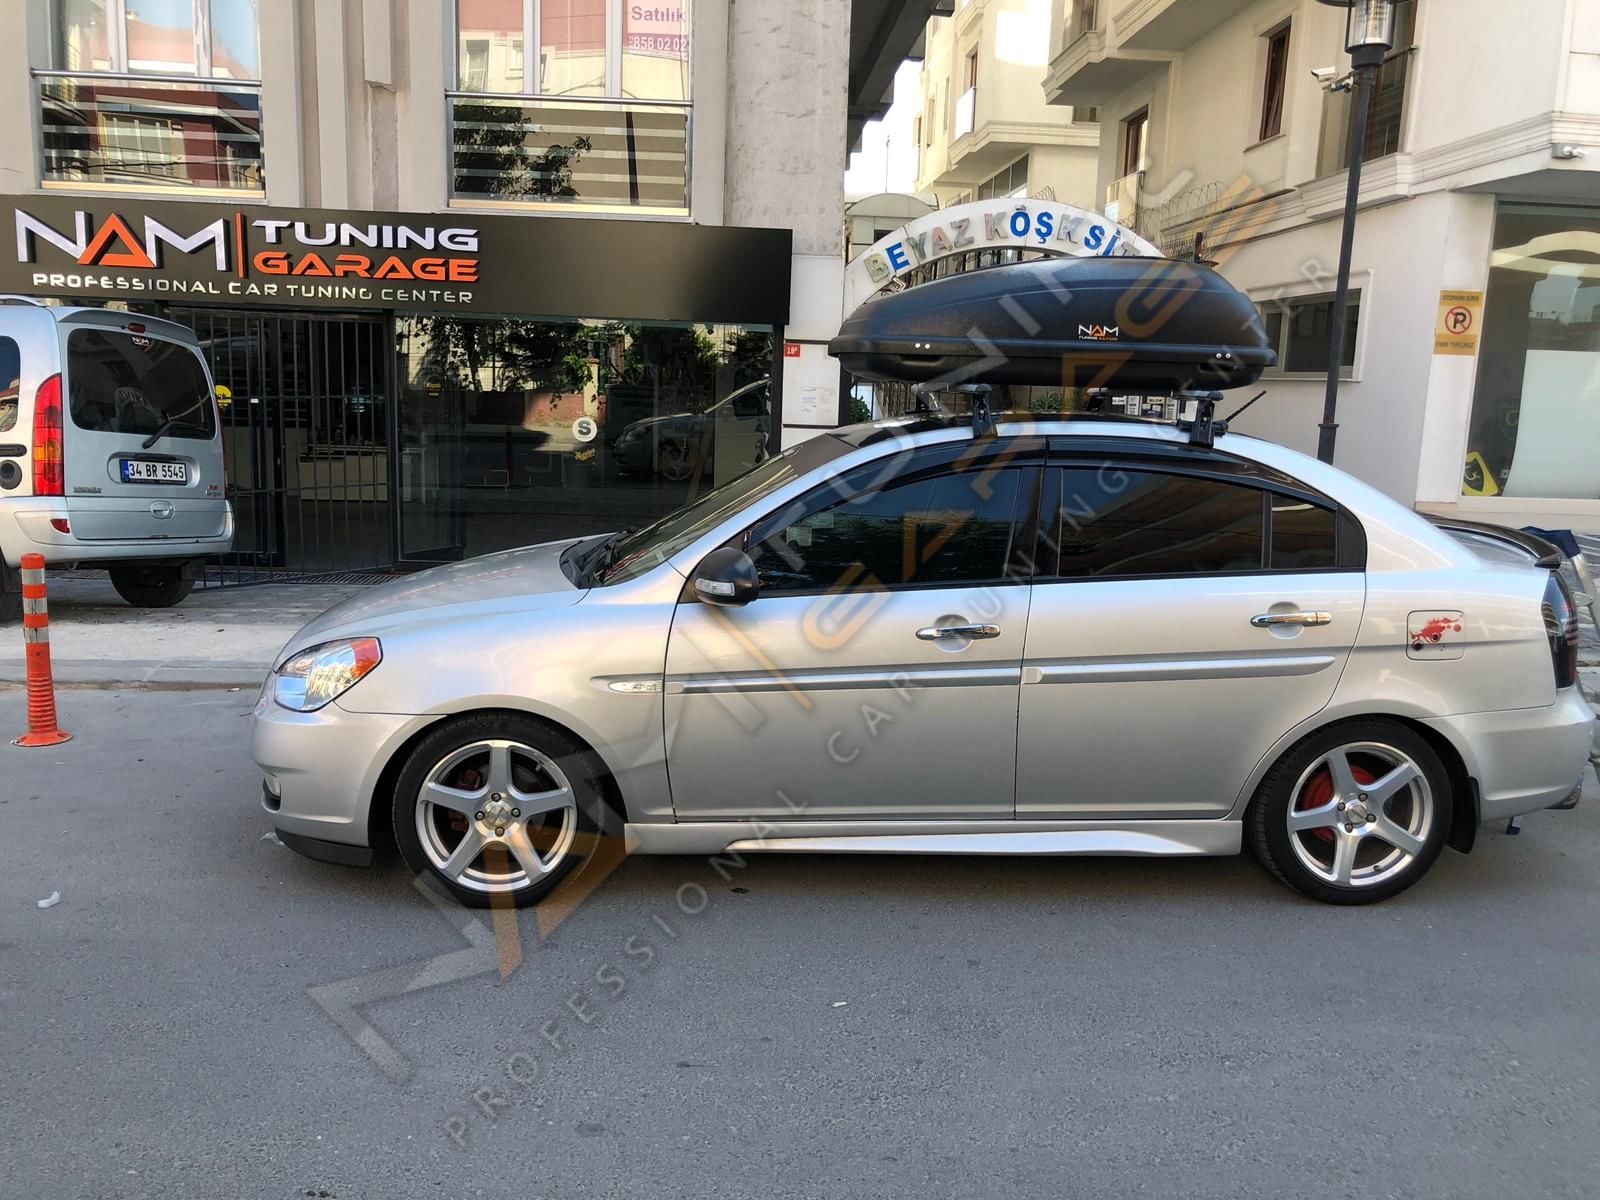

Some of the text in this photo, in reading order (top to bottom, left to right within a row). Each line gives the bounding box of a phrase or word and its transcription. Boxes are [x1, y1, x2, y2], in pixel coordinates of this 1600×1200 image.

[633, 36, 655, 50] 858
[656, 38, 671, 51] 02
[673, 39, 687, 51] 02
[14, 208, 228, 272] NAM
[252, 219, 479, 252] TUNING
[862, 216, 975, 283] BEYAZ
[984, 203, 1084, 244] KÖŞK
[253, 251, 479, 282] GARAGE
[32, 273, 473, 304] PROFESSIONAL CAR TUNING CENTER
[1078, 324, 1119, 336] NAM
[578, 420, 592, 436] S
[128, 463, 142, 477] 34
[145, 464, 158, 478] BR
[161, 466, 185, 479] 5545
